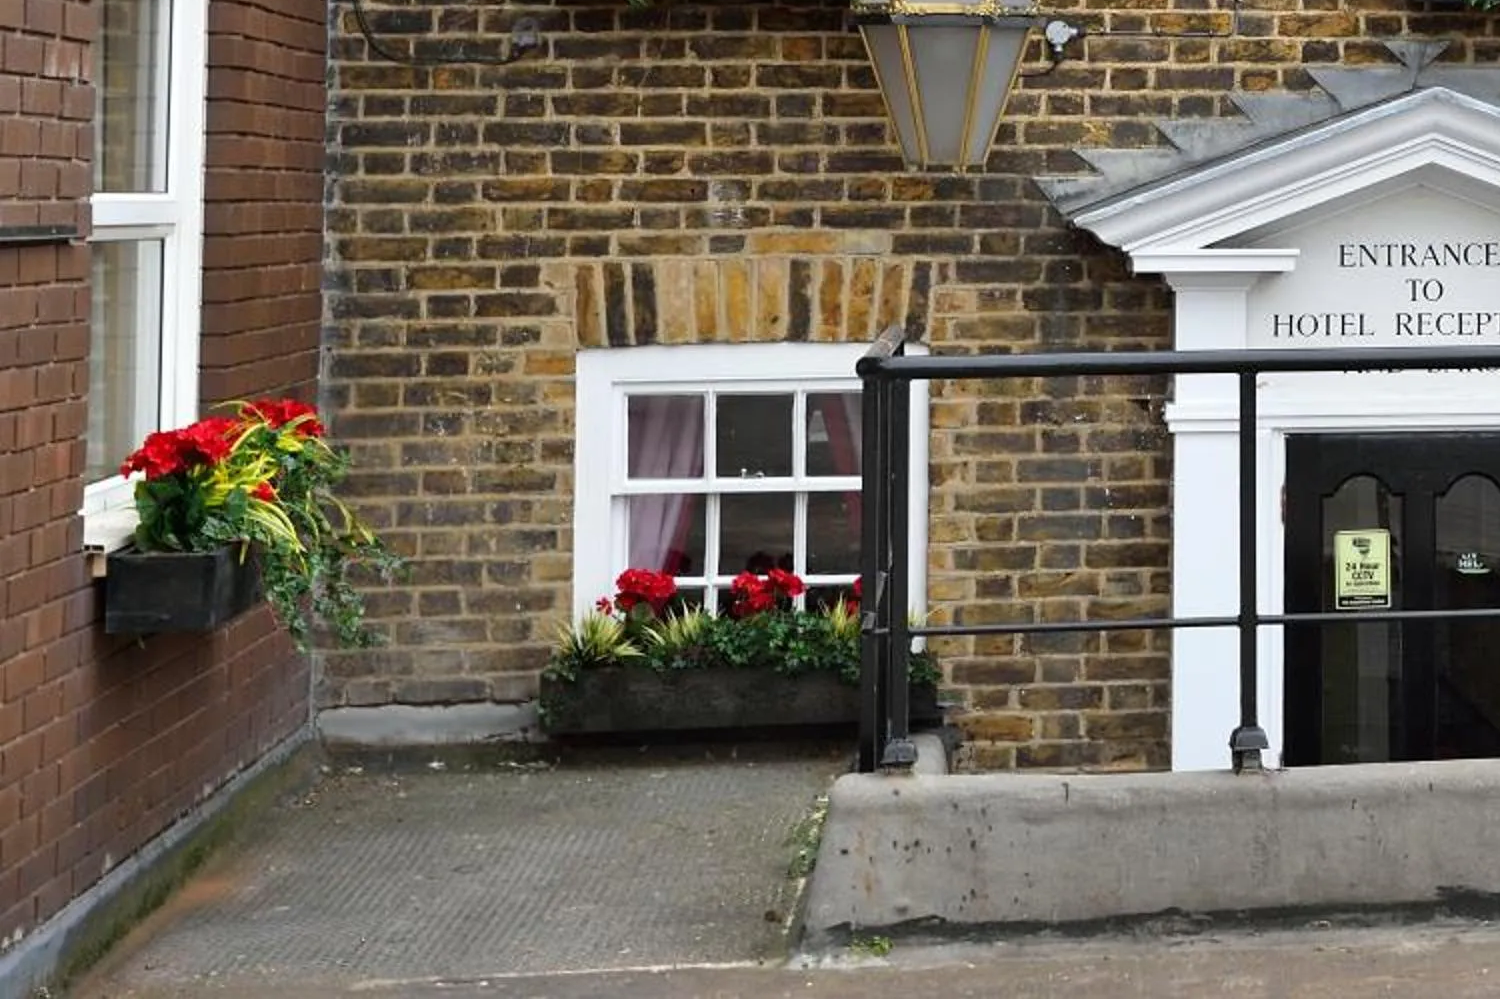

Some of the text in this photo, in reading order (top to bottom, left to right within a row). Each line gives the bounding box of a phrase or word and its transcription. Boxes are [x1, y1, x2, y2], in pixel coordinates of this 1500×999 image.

[1338, 242, 1500, 268] ENTRANCE
[1406, 278, 1444, 302] TO
[1272, 313, 1375, 338] HOTEL
